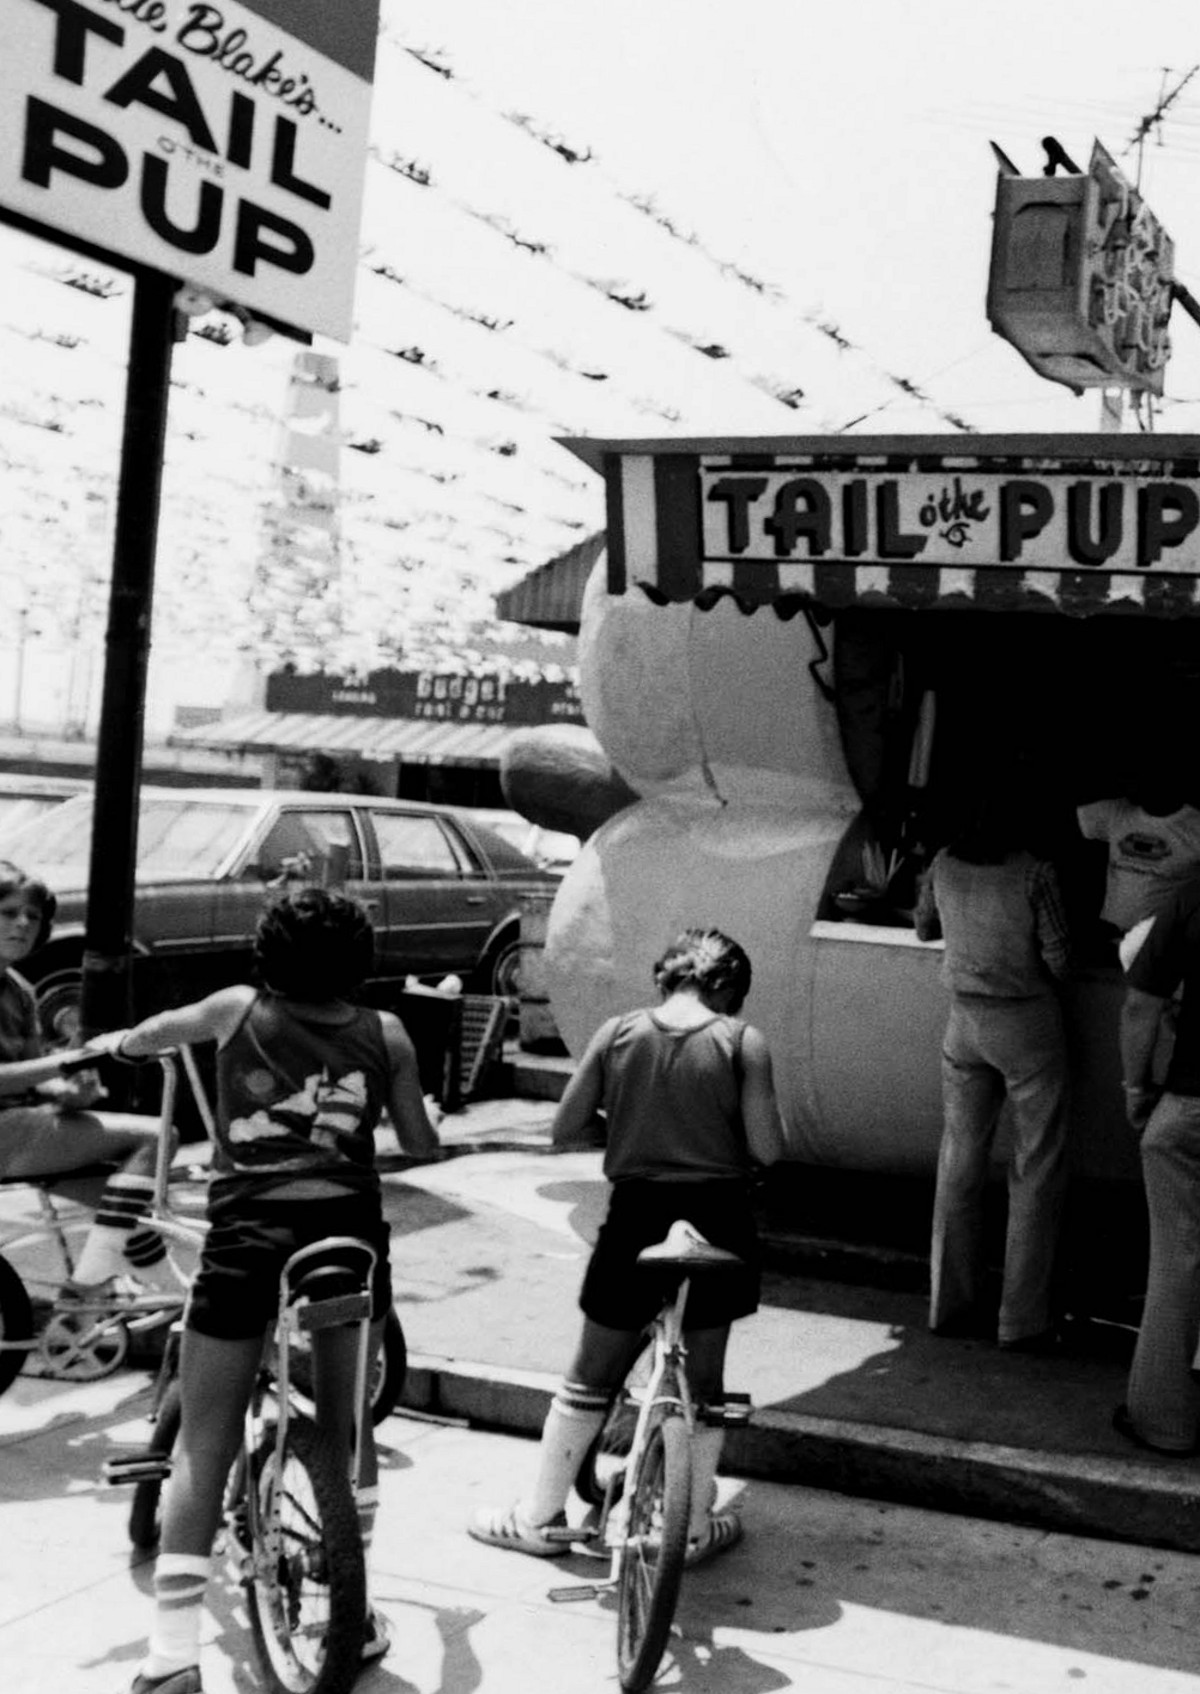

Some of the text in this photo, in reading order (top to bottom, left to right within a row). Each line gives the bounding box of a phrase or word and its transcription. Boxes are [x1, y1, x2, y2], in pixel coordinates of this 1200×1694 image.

[20, 94, 316, 279] PUP
[32, 0, 332, 212] TAIL
[707, 476, 929, 559] TAIL
[999, 479, 1200, 567] PUP
